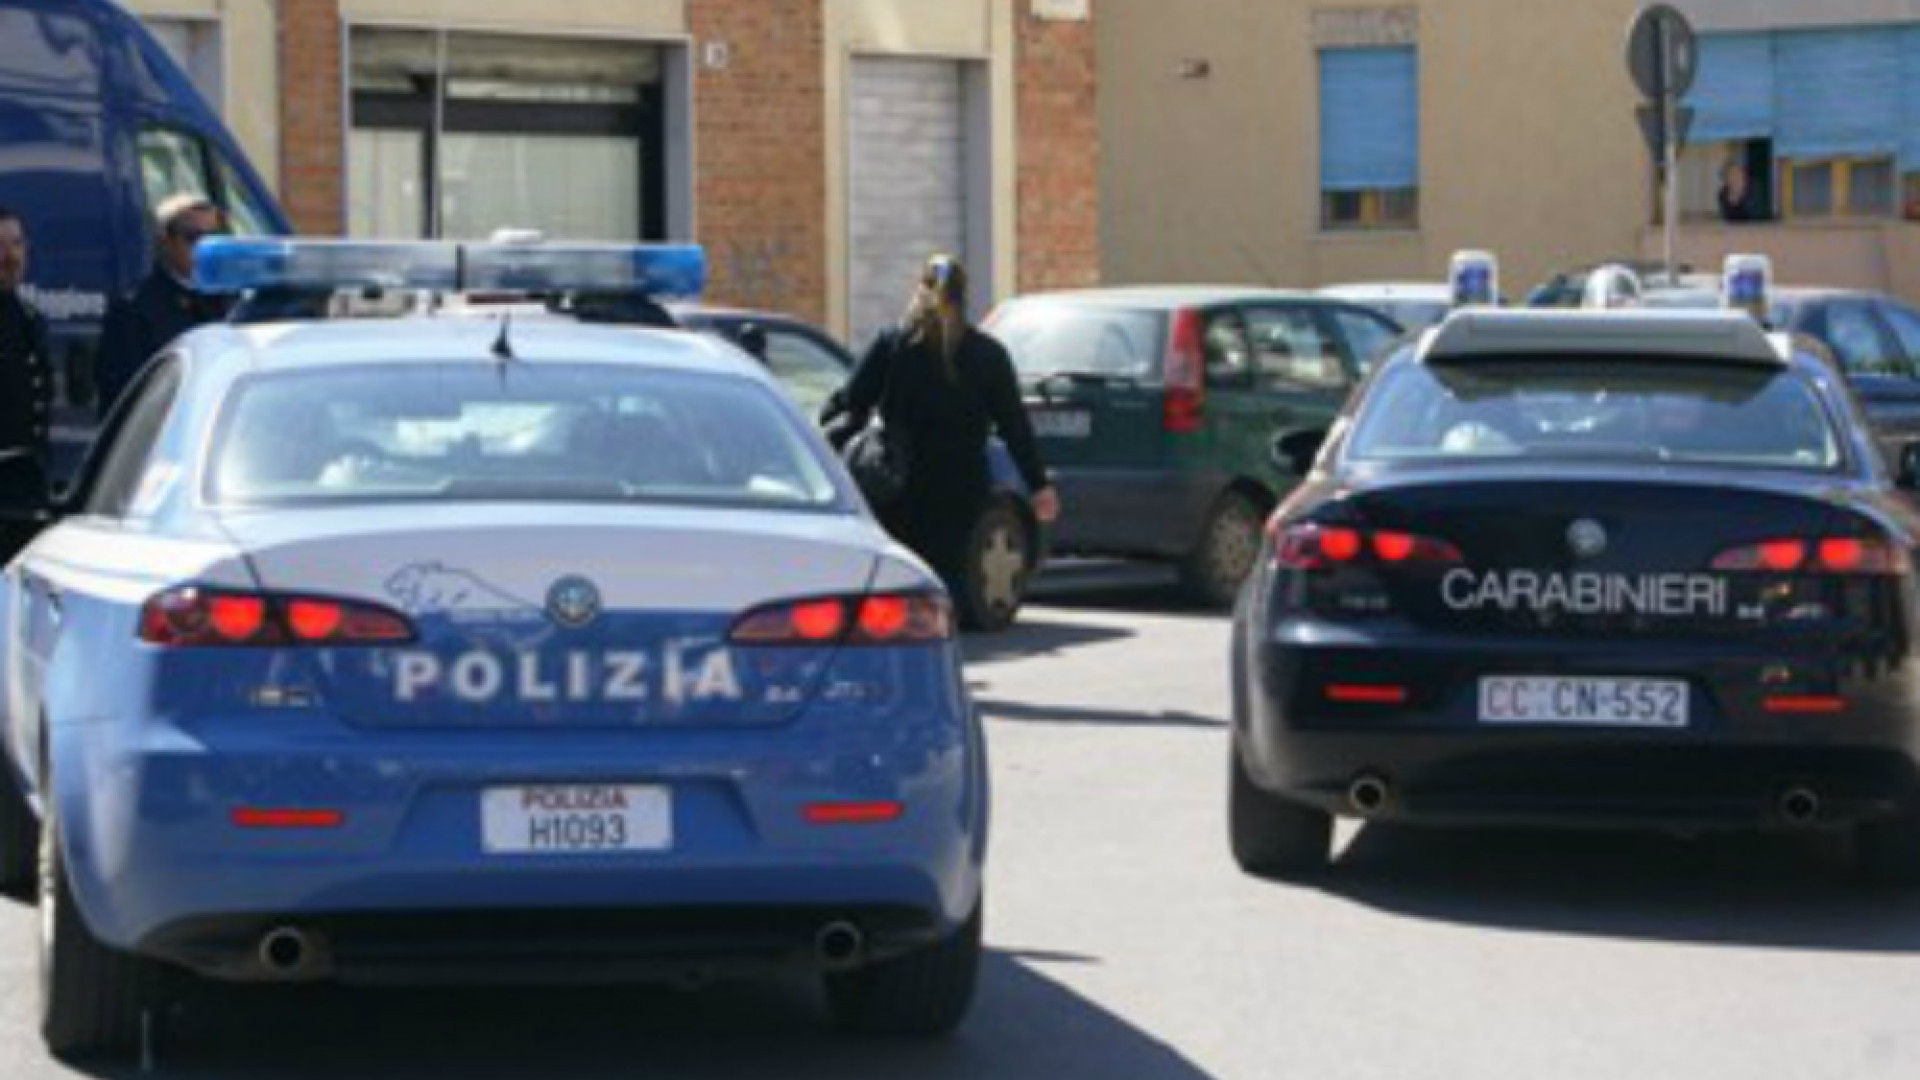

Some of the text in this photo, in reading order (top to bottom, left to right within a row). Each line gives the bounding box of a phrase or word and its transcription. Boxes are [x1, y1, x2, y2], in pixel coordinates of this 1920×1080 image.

[1442, 568, 1727, 615] CARABINIERI
[395, 650, 742, 700] POLIZIA
[521, 785, 628, 809] POLIZIA
[530, 813, 626, 847] H1093
